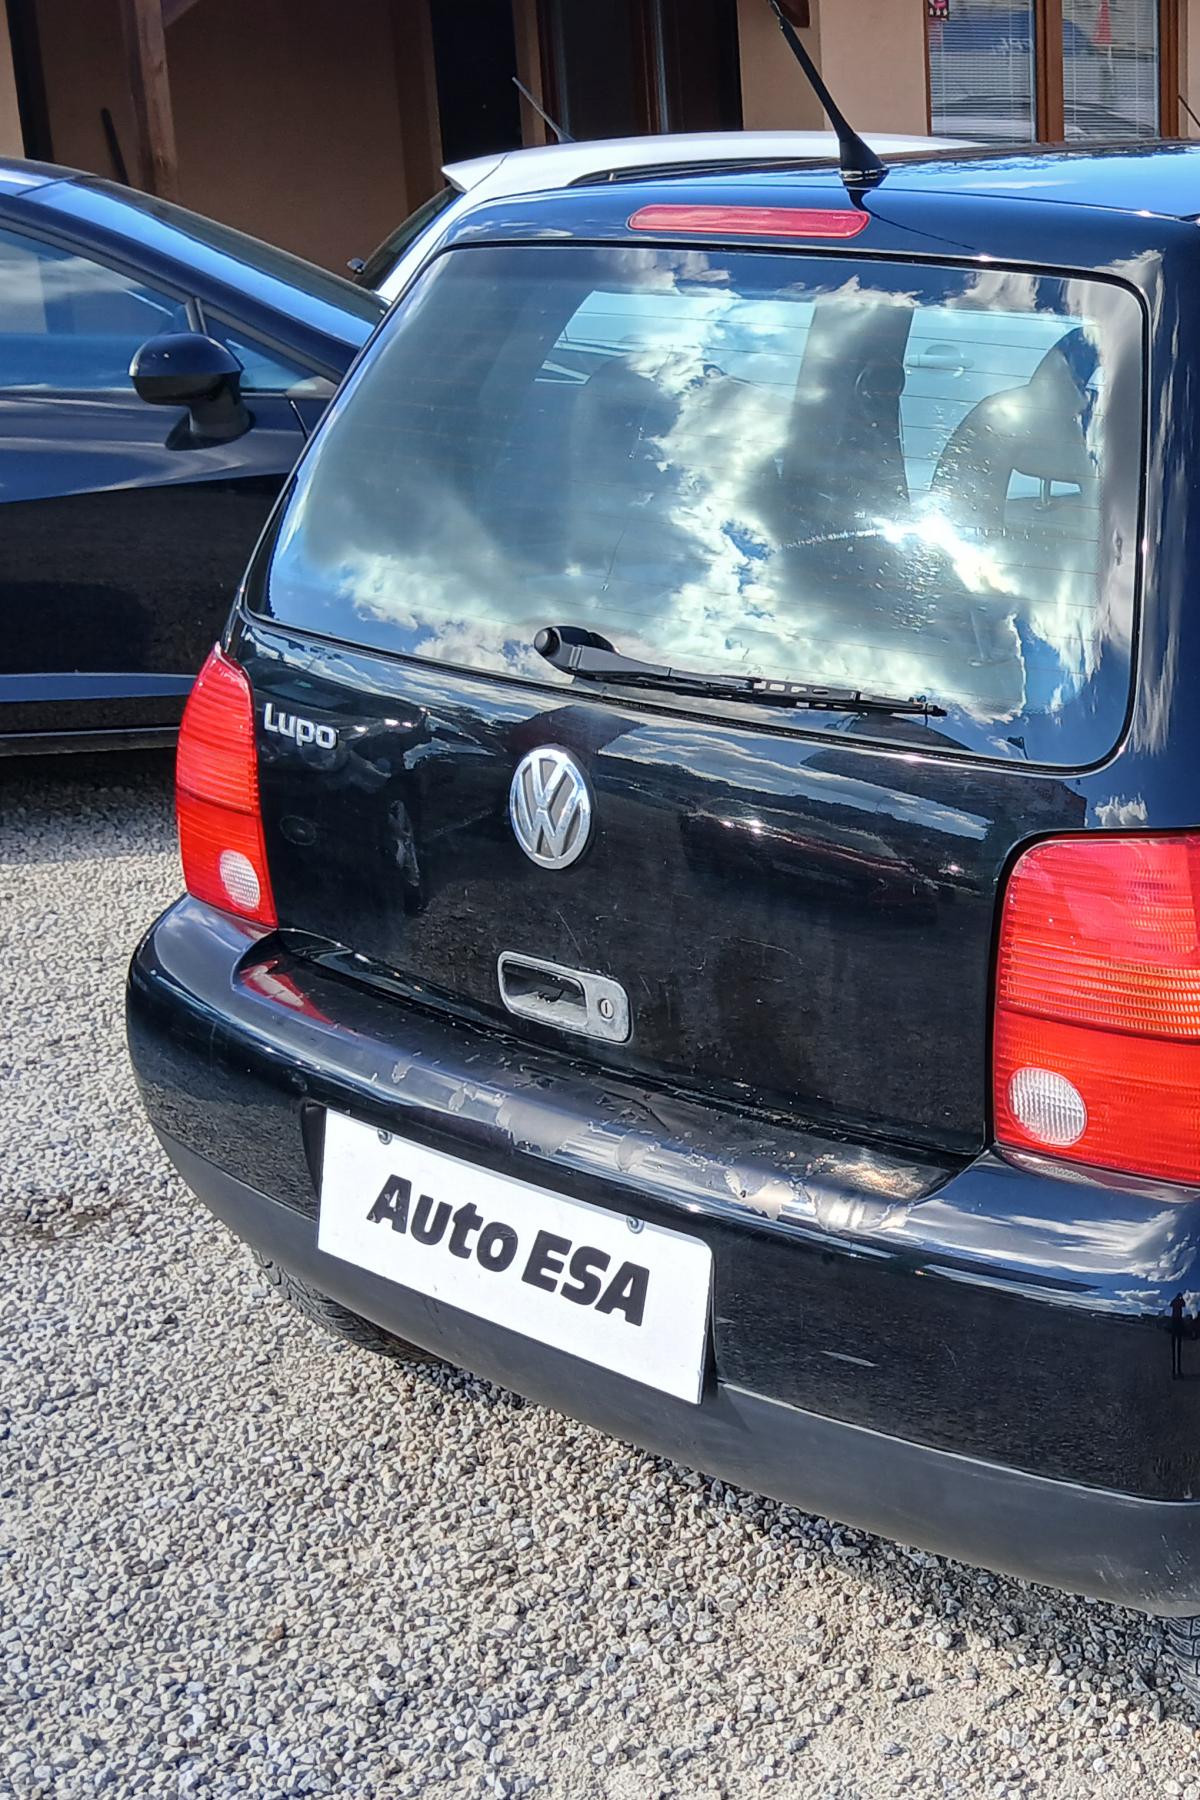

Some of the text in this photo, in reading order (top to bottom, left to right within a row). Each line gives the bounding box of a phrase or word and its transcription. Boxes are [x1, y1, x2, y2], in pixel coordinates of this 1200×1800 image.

[263, 702, 338, 750] Lupo
[510, 748, 591, 870] VW
[366, 1173, 650, 1327] Auto ESA
